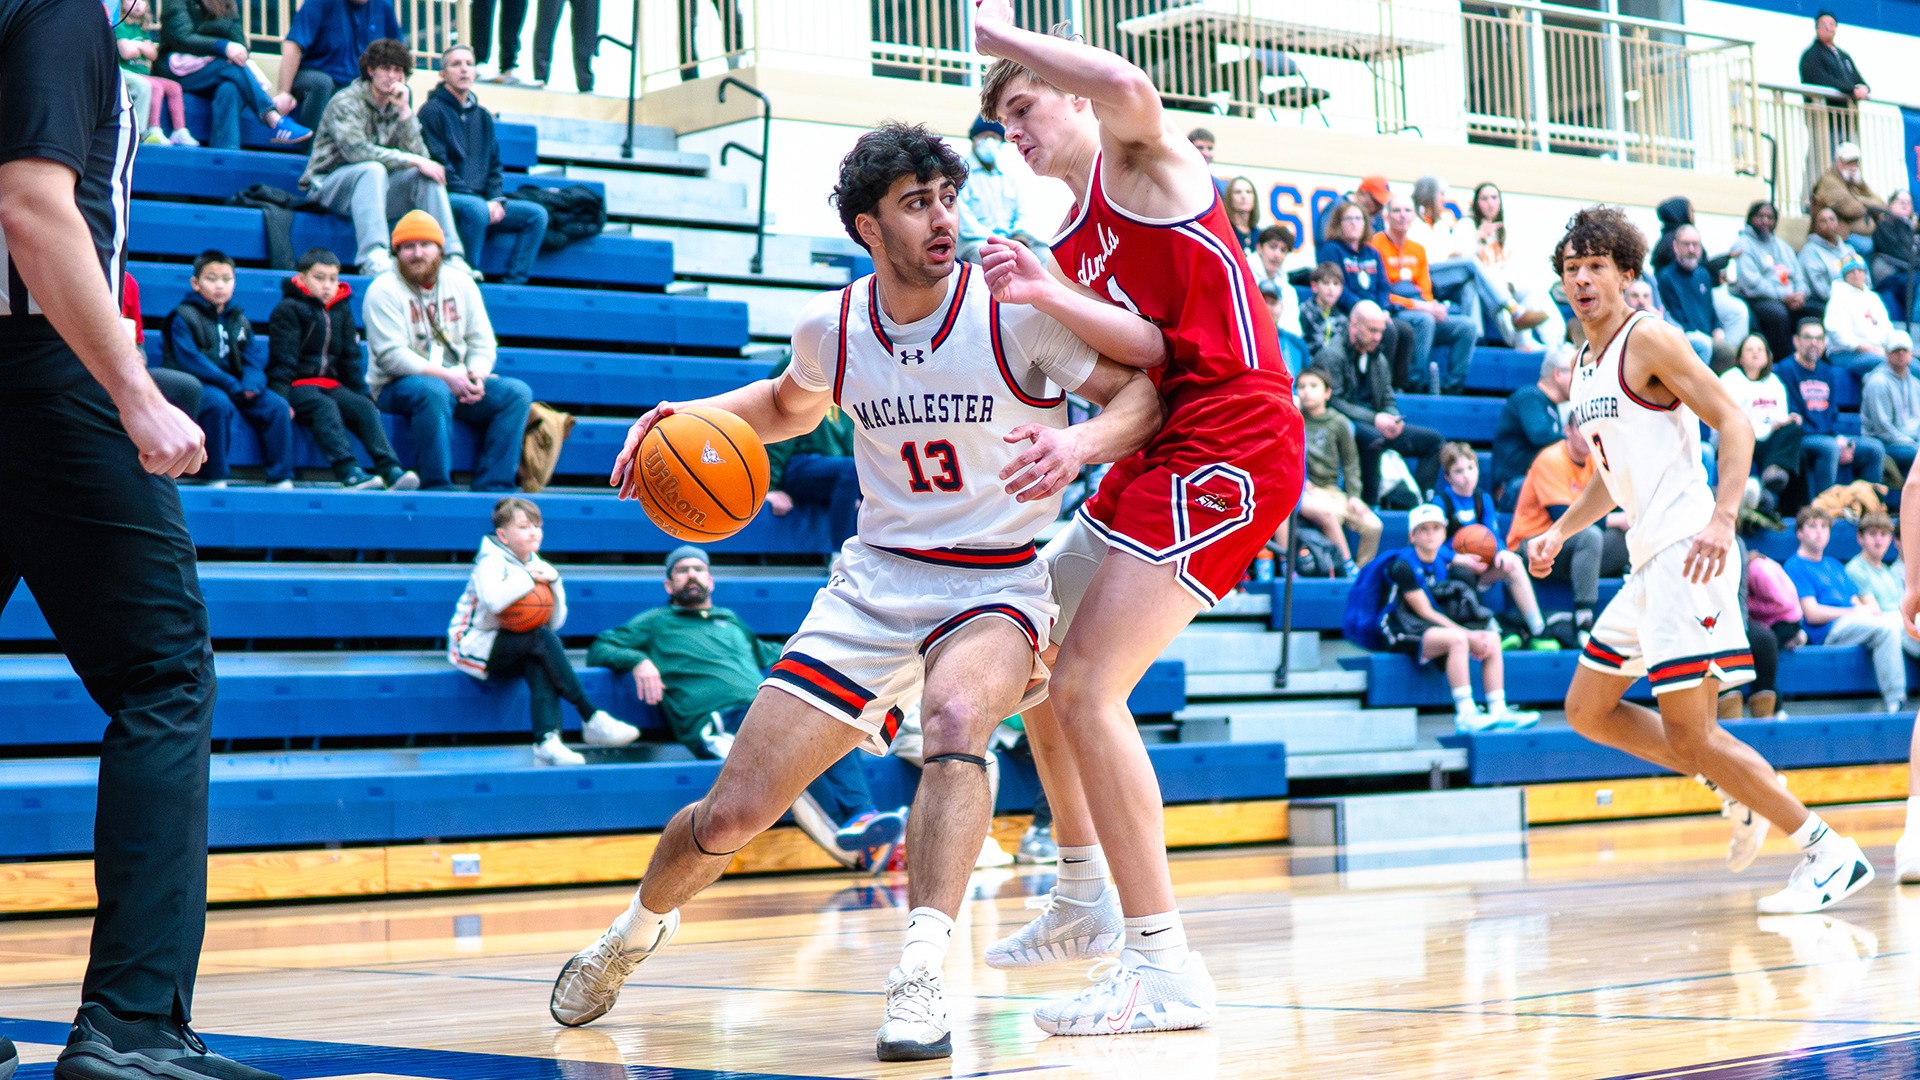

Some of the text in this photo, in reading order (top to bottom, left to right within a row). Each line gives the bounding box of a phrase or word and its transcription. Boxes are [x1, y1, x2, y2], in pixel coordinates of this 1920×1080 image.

[852, 393, 995, 431] MACALESTER
[1574, 395, 1620, 429] CALESTER
[644, 443, 708, 527] Wilson
[900, 438, 964, 493] 13
